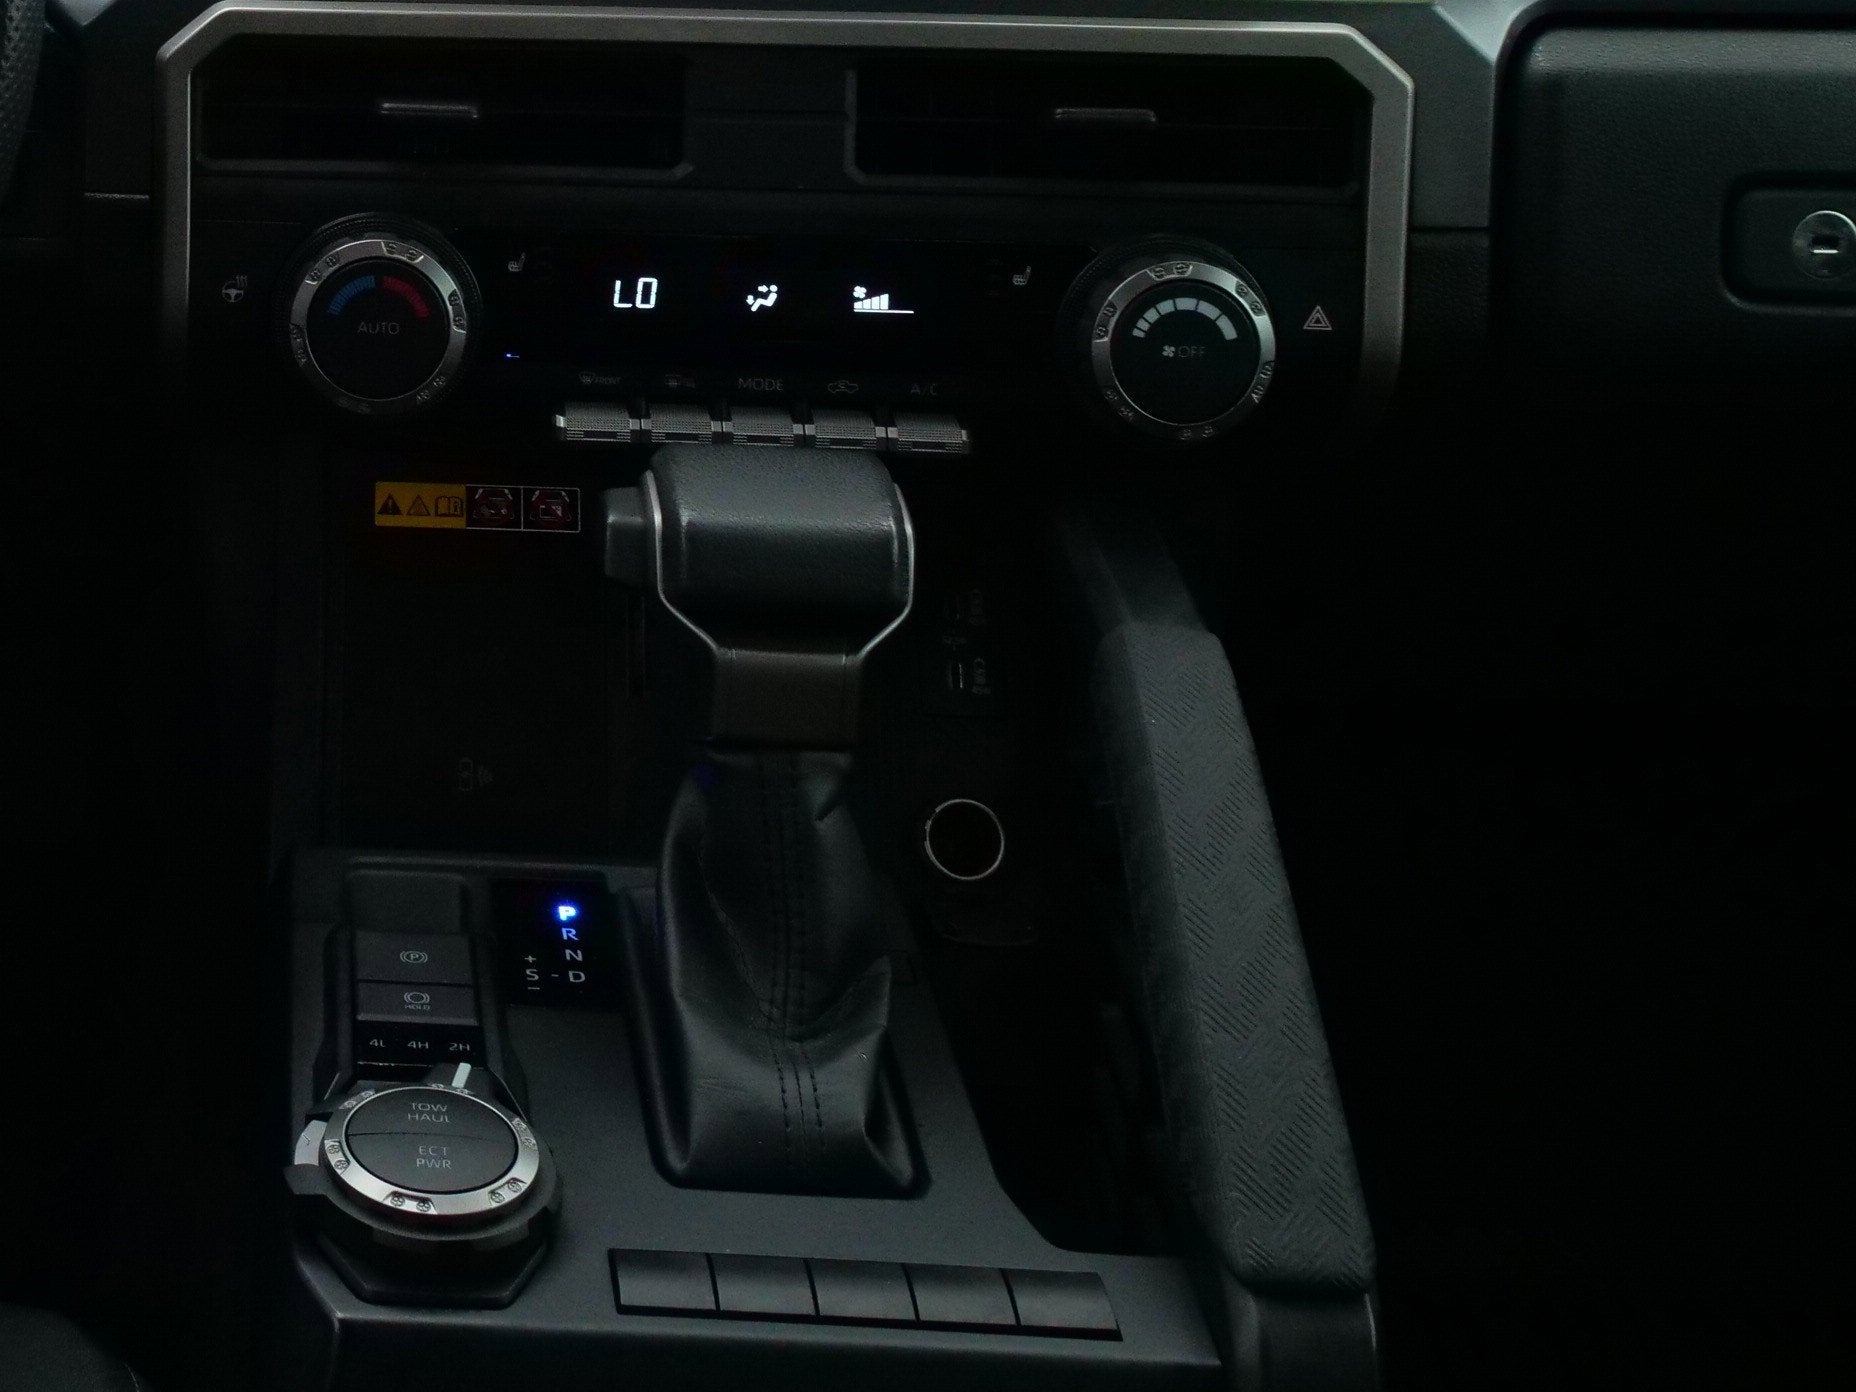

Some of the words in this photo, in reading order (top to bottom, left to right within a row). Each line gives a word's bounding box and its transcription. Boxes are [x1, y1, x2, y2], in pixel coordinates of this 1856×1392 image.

[613, 277, 658, 309] LO
[357, 321, 400, 336] AUTO
[737, 378, 784, 392] MODE
[910, 384, 938, 396] A/C
[558, 906, 576, 921] P
[561, 928, 579, 940] R
[565, 949, 583, 961] N
[526, 969, 539, 981] S
[568, 971, 585, 982] D
[369, 1039, 385, 1048] 4L
[406, 1041, 429, 1049] 4H
[449, 1043, 470, 1051] 2H
[411, 1102, 448, 1112] TOW
[408, 1113, 450, 1123] HAUL
[419, 1146, 449, 1156] ECT
[416, 1158, 451, 1169] PWR
